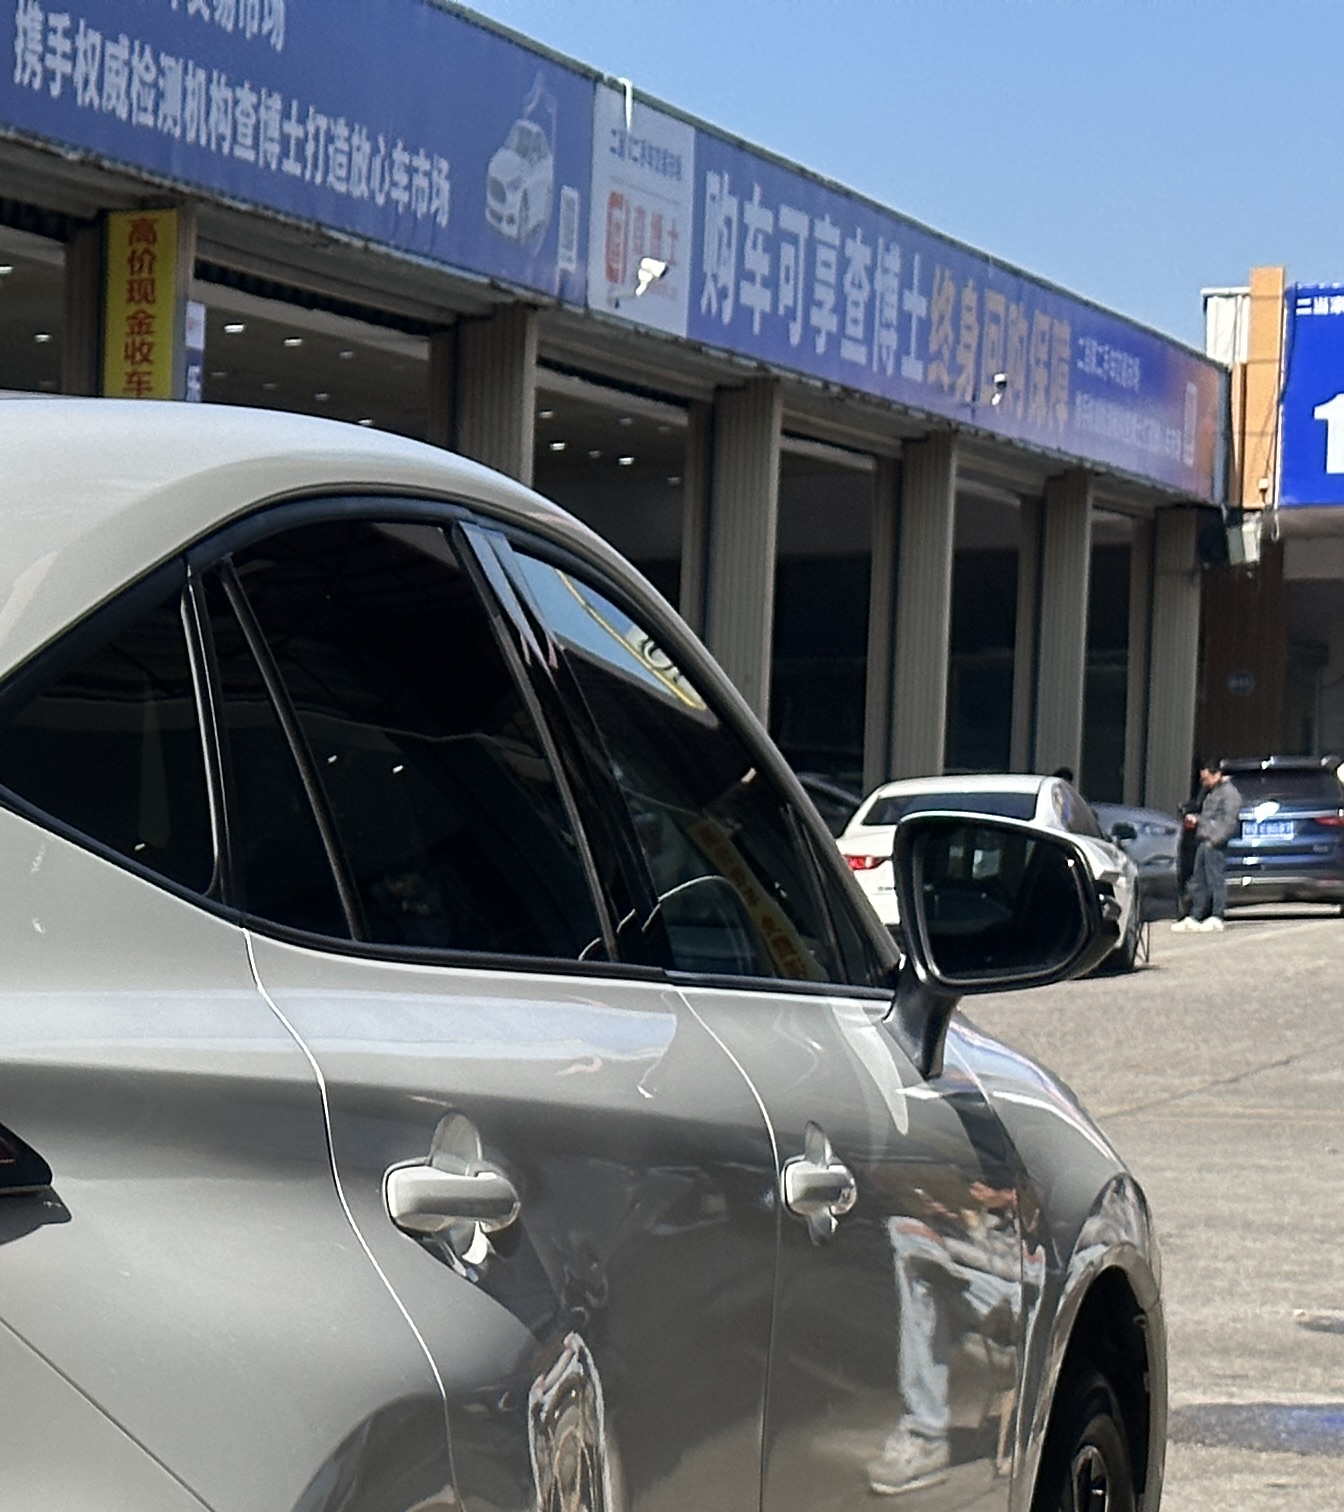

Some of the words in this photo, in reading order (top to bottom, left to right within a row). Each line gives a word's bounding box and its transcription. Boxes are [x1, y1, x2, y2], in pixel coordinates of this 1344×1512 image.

[13, 2, 451, 228] 携手权威检测机构查博士打造放心车市场
[123, 217, 158, 397] 高价现金收车
